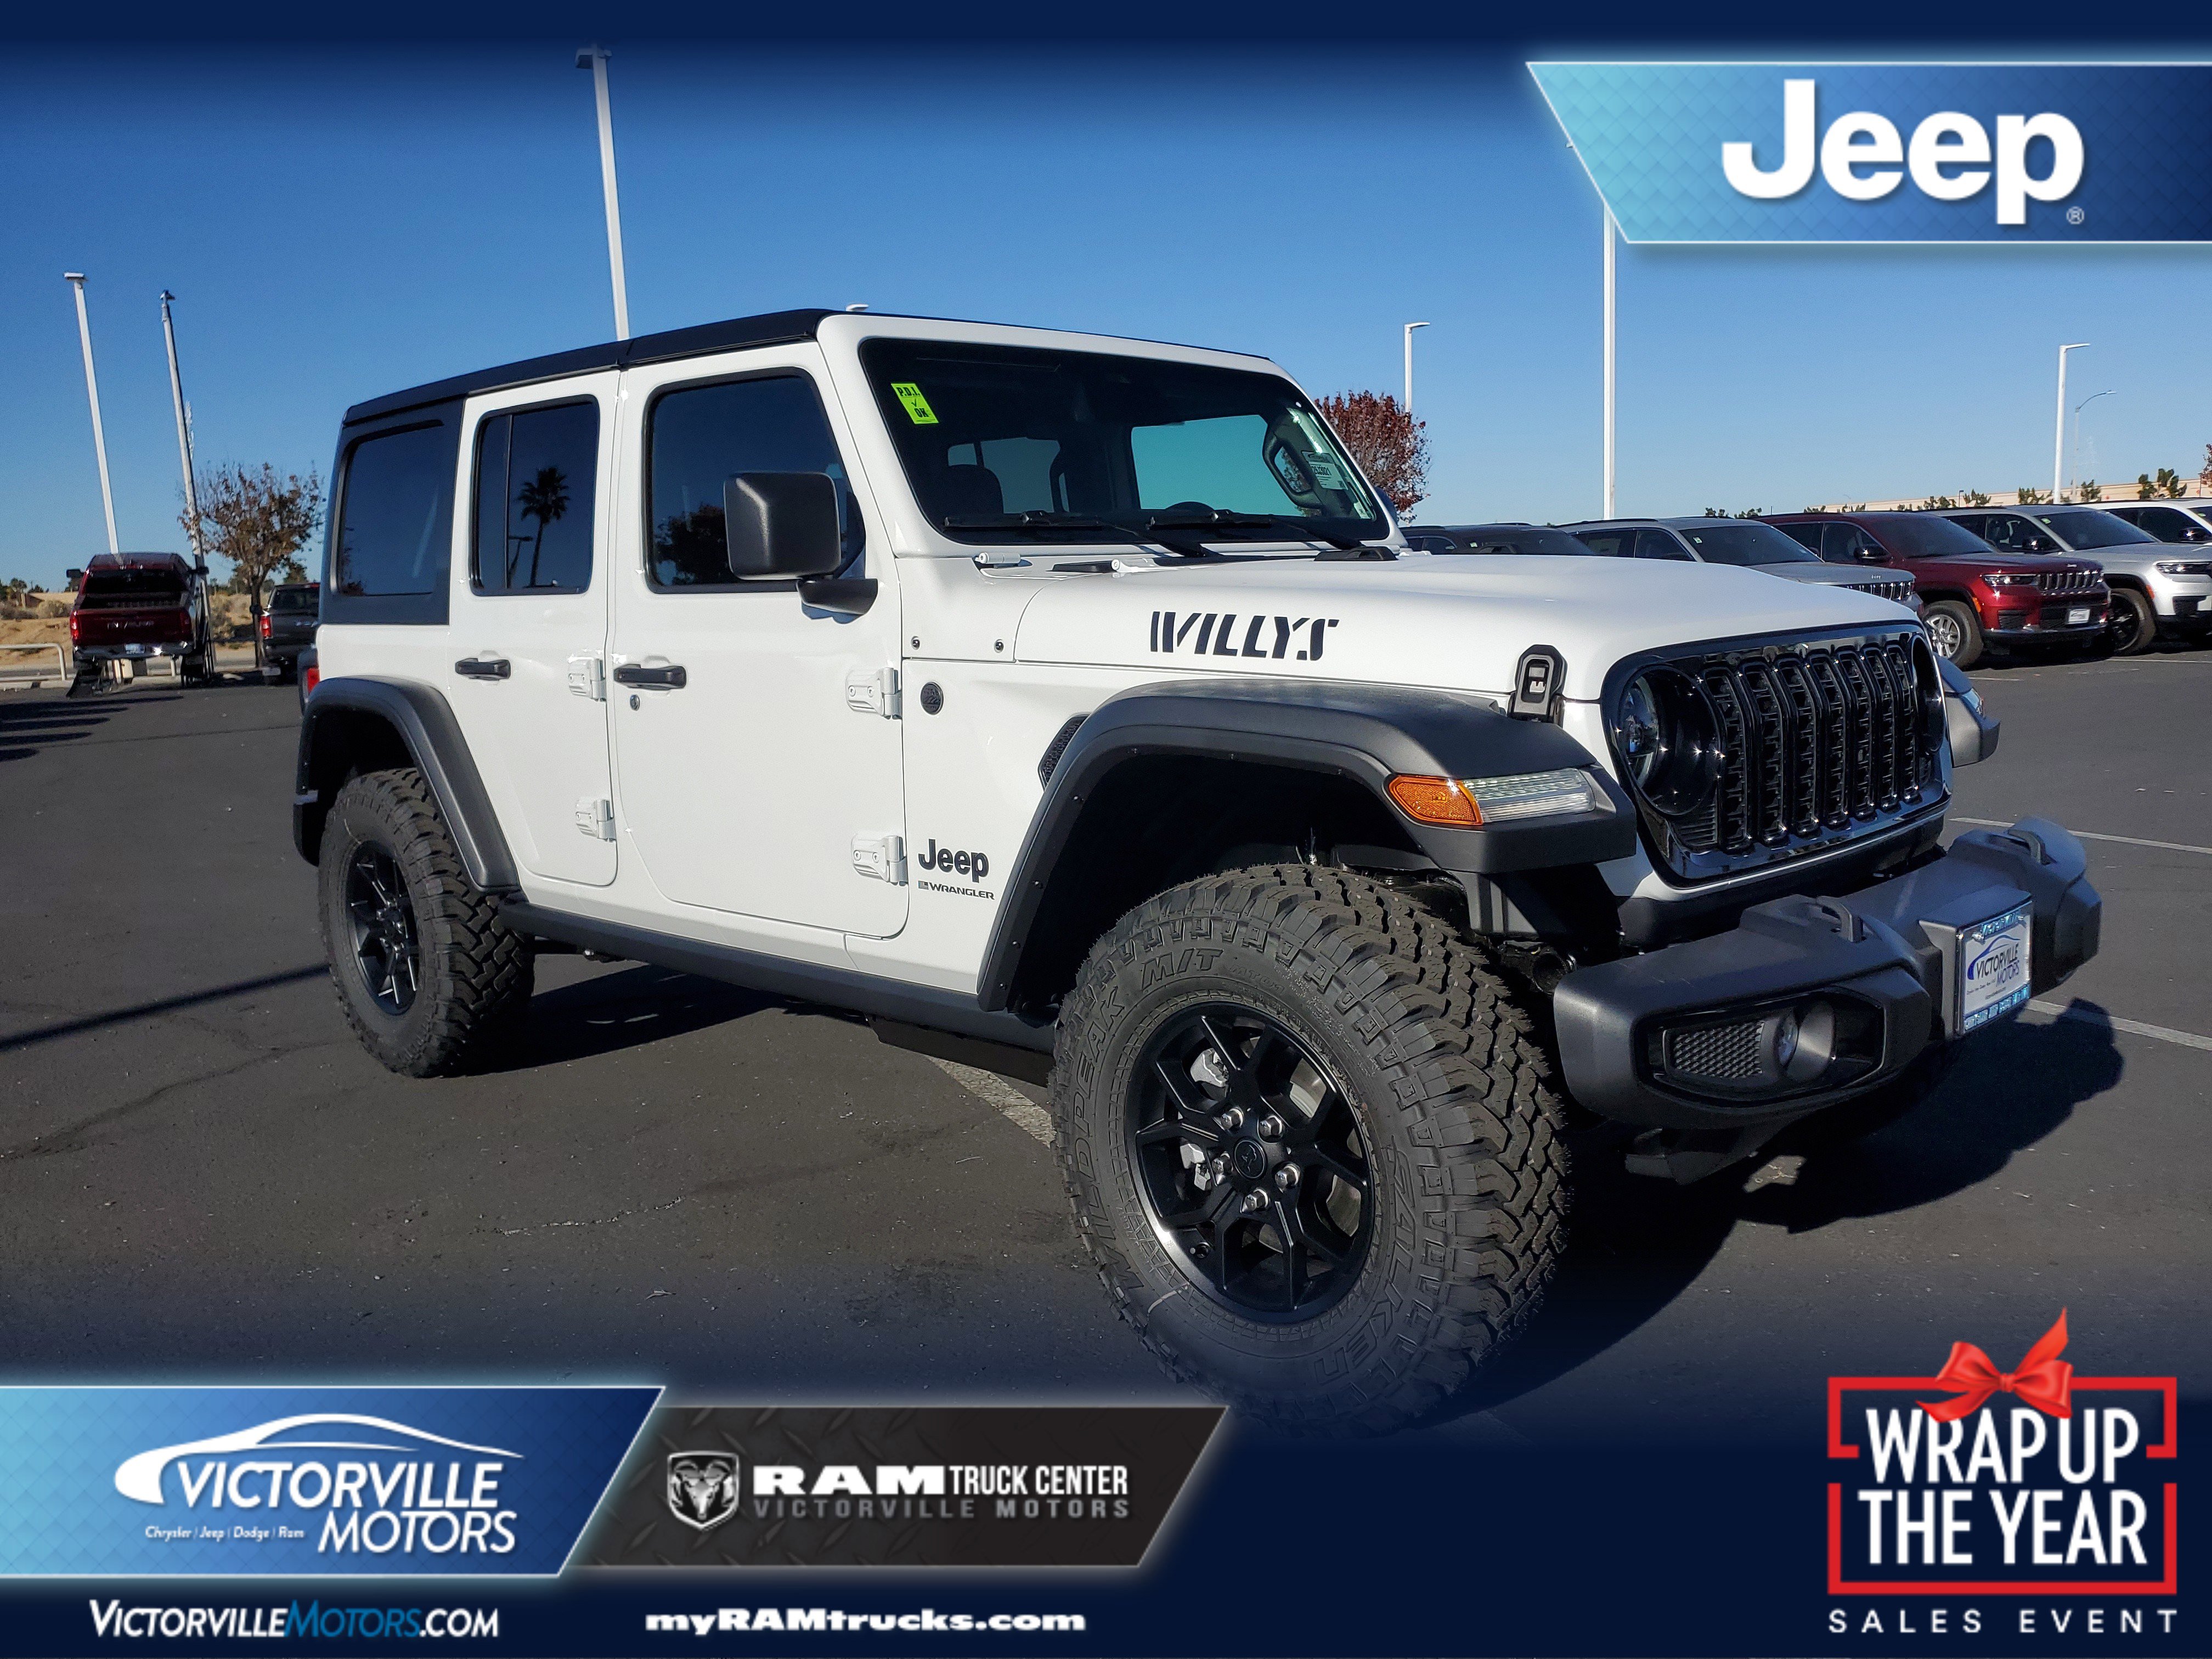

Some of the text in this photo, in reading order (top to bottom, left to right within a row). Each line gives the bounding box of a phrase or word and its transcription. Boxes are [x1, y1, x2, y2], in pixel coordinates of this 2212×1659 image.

[913, 408, 930, 418] OK
[1150, 610, 1340, 662] WILLYS
[918, 838, 989, 883] Jeep
[928, 882, 995, 900] WRANGLER
[1141, 947, 1224, 991] M/T
[1977, 943, 2019, 979] VICTORVILLE
